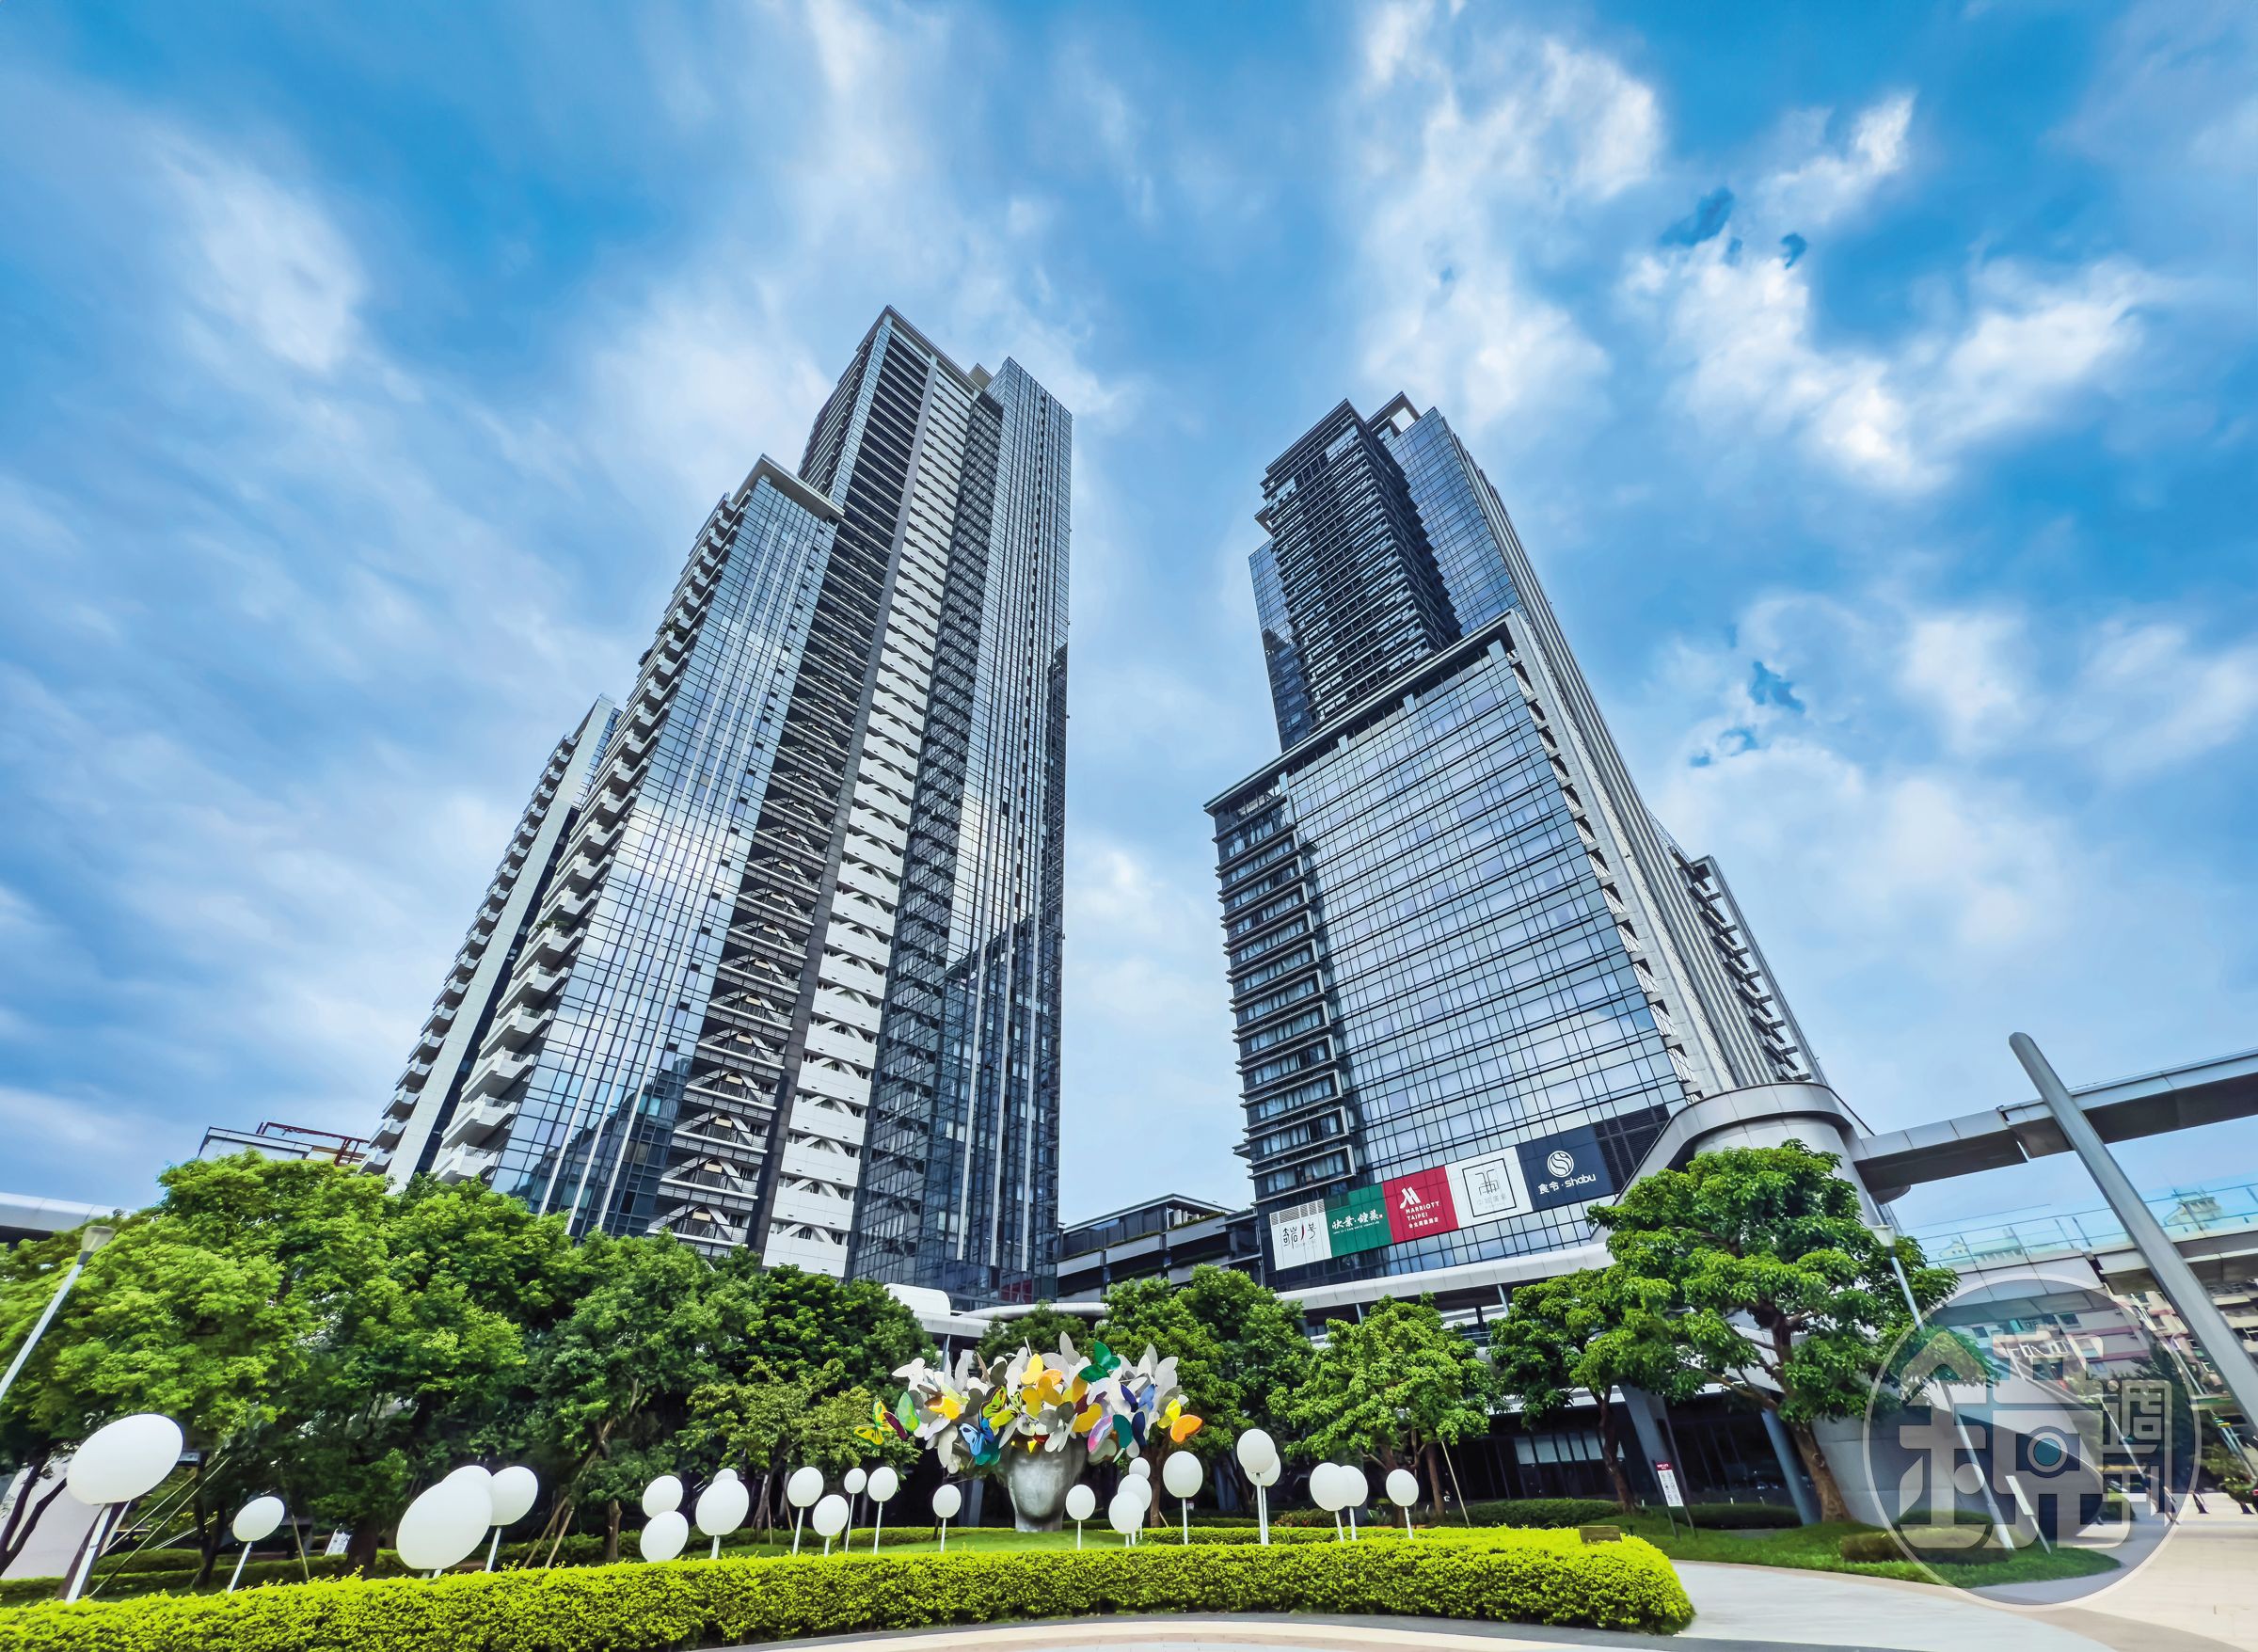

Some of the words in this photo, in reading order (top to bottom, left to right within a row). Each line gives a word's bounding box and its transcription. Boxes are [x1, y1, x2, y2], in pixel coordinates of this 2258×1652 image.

[1565, 1174, 1596, 1187] shabu
[1406, 1200, 1439, 1214] MARRIOTT
[1407, 1212, 1428, 1221] TAIPEI
